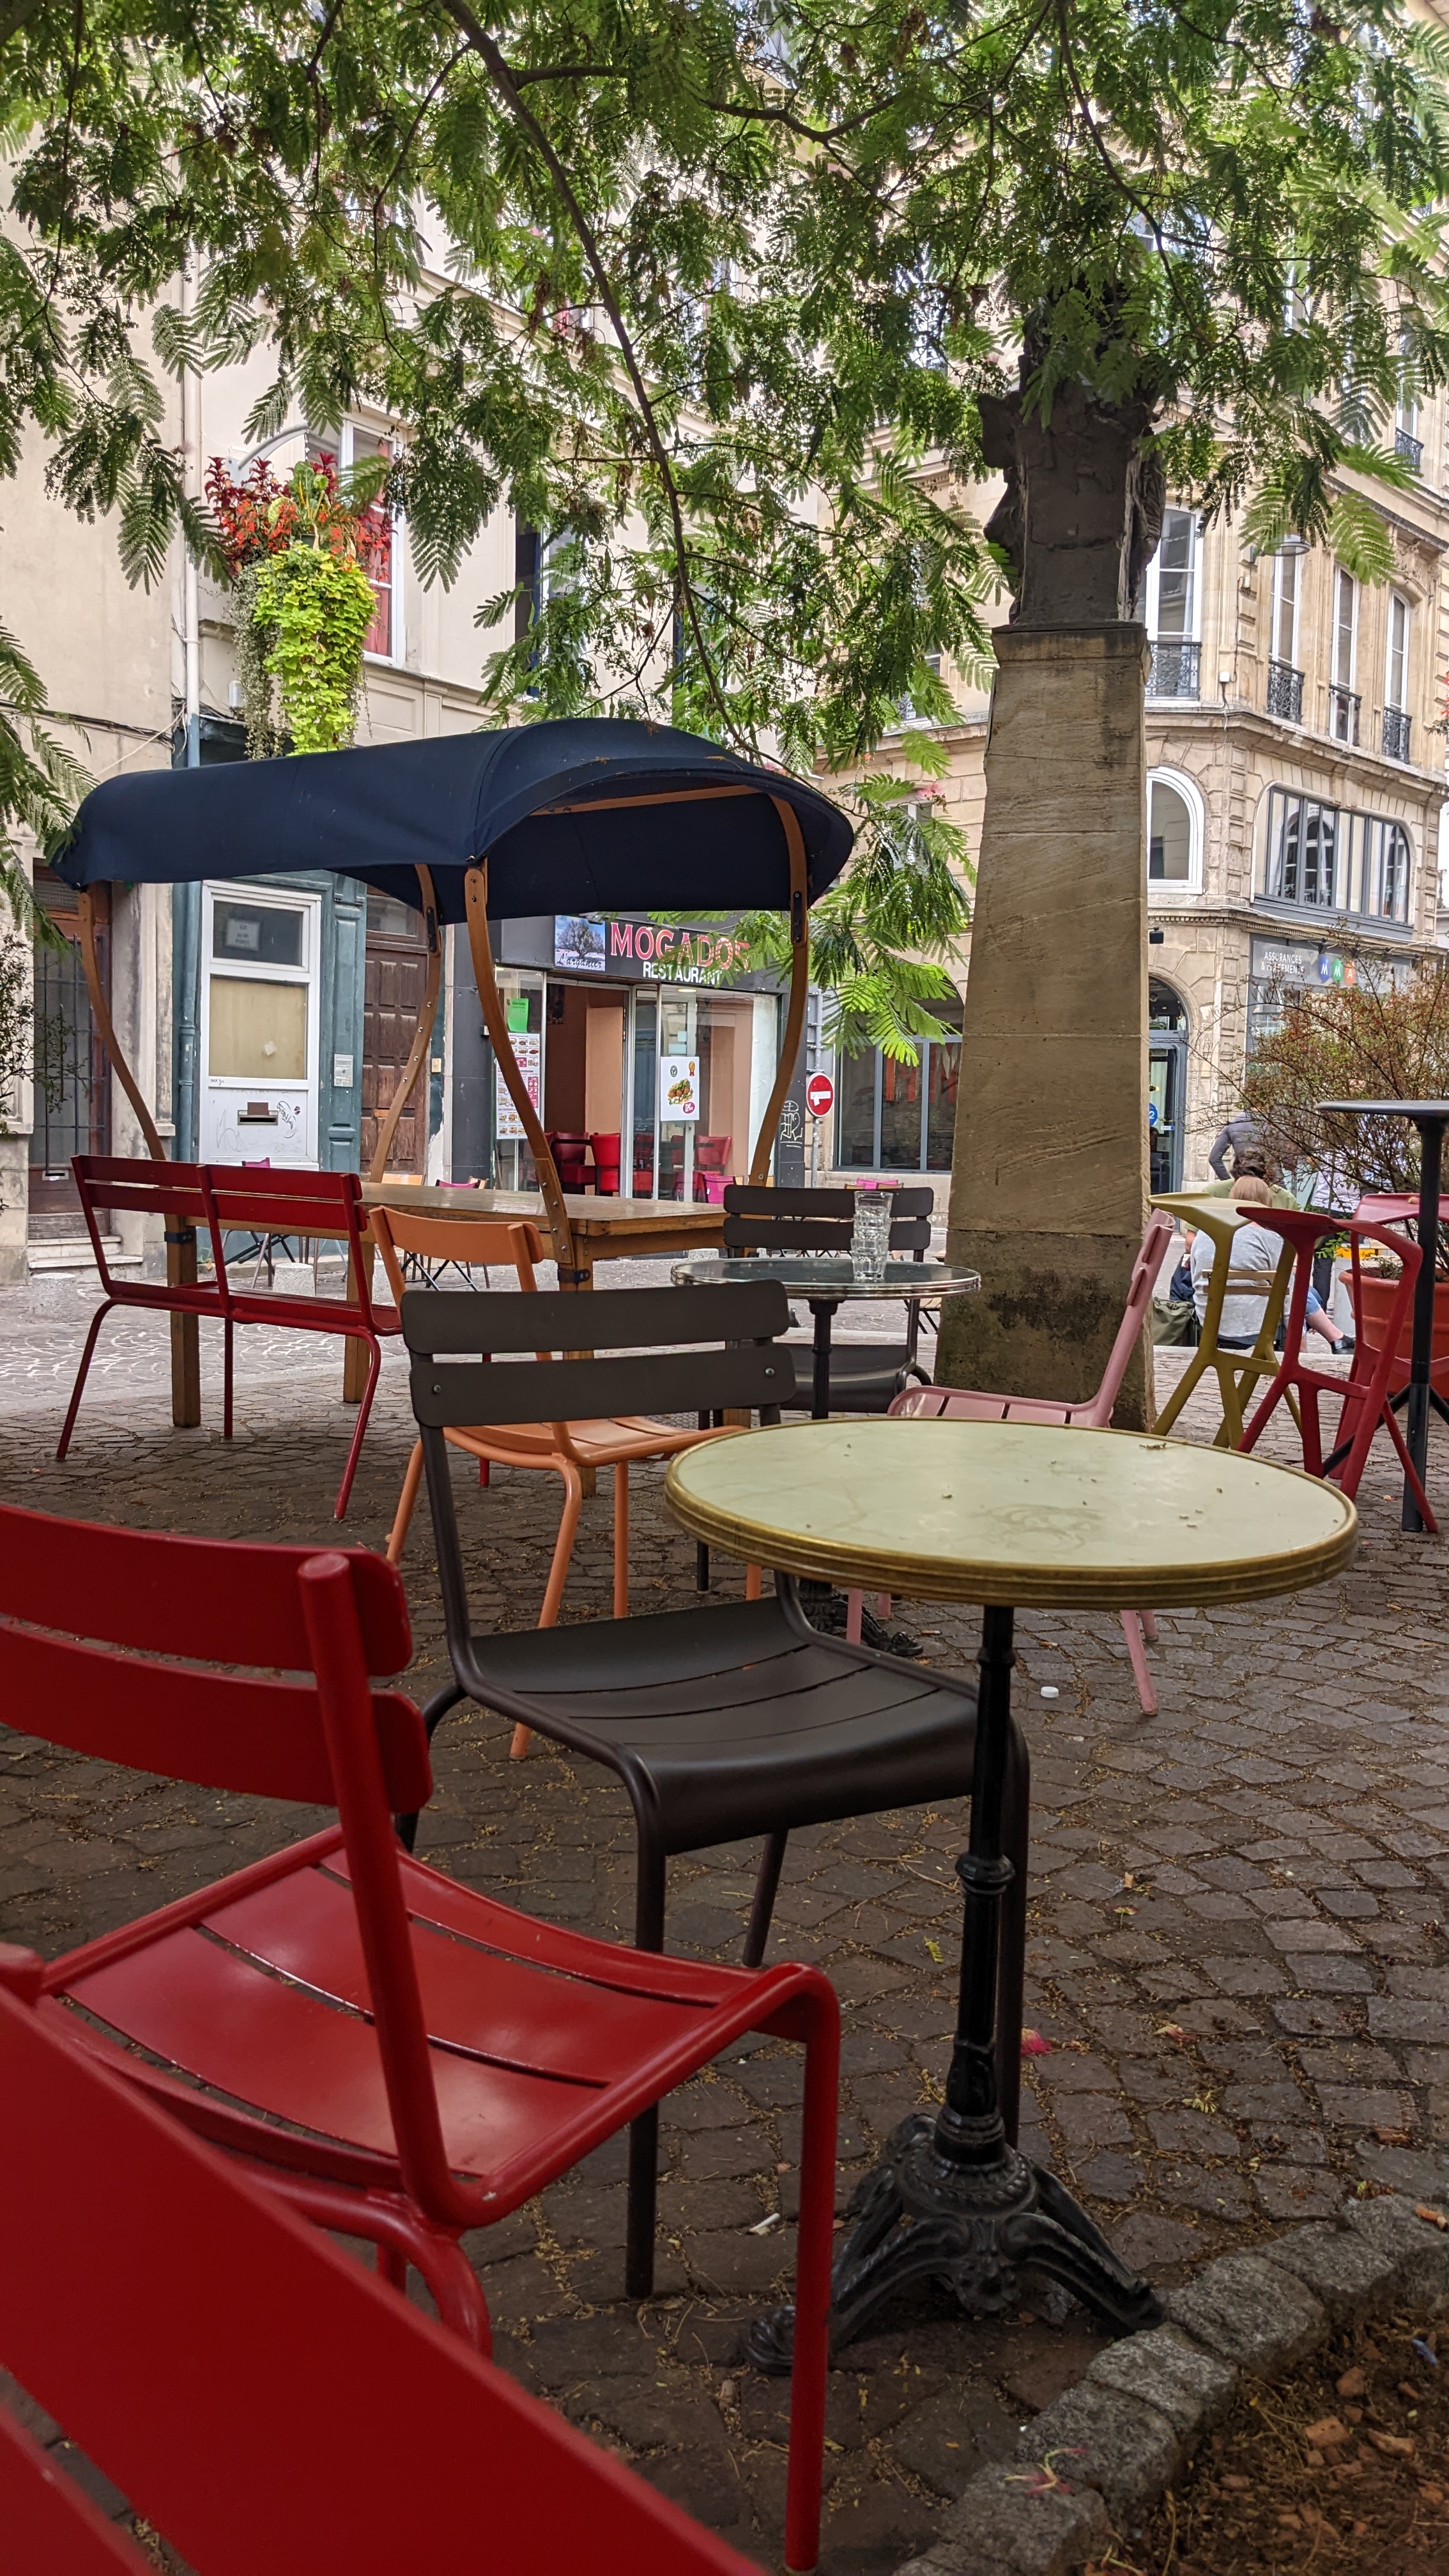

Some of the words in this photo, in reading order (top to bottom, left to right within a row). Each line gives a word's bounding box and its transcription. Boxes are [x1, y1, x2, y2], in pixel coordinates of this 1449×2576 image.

[1264, 951, 1302, 965] ASSURANCES
[643, 961, 723, 986] RESTAURANT
[1261, 962, 1265, 970] &
[1266, 962, 1305, 975] PLEMENS
